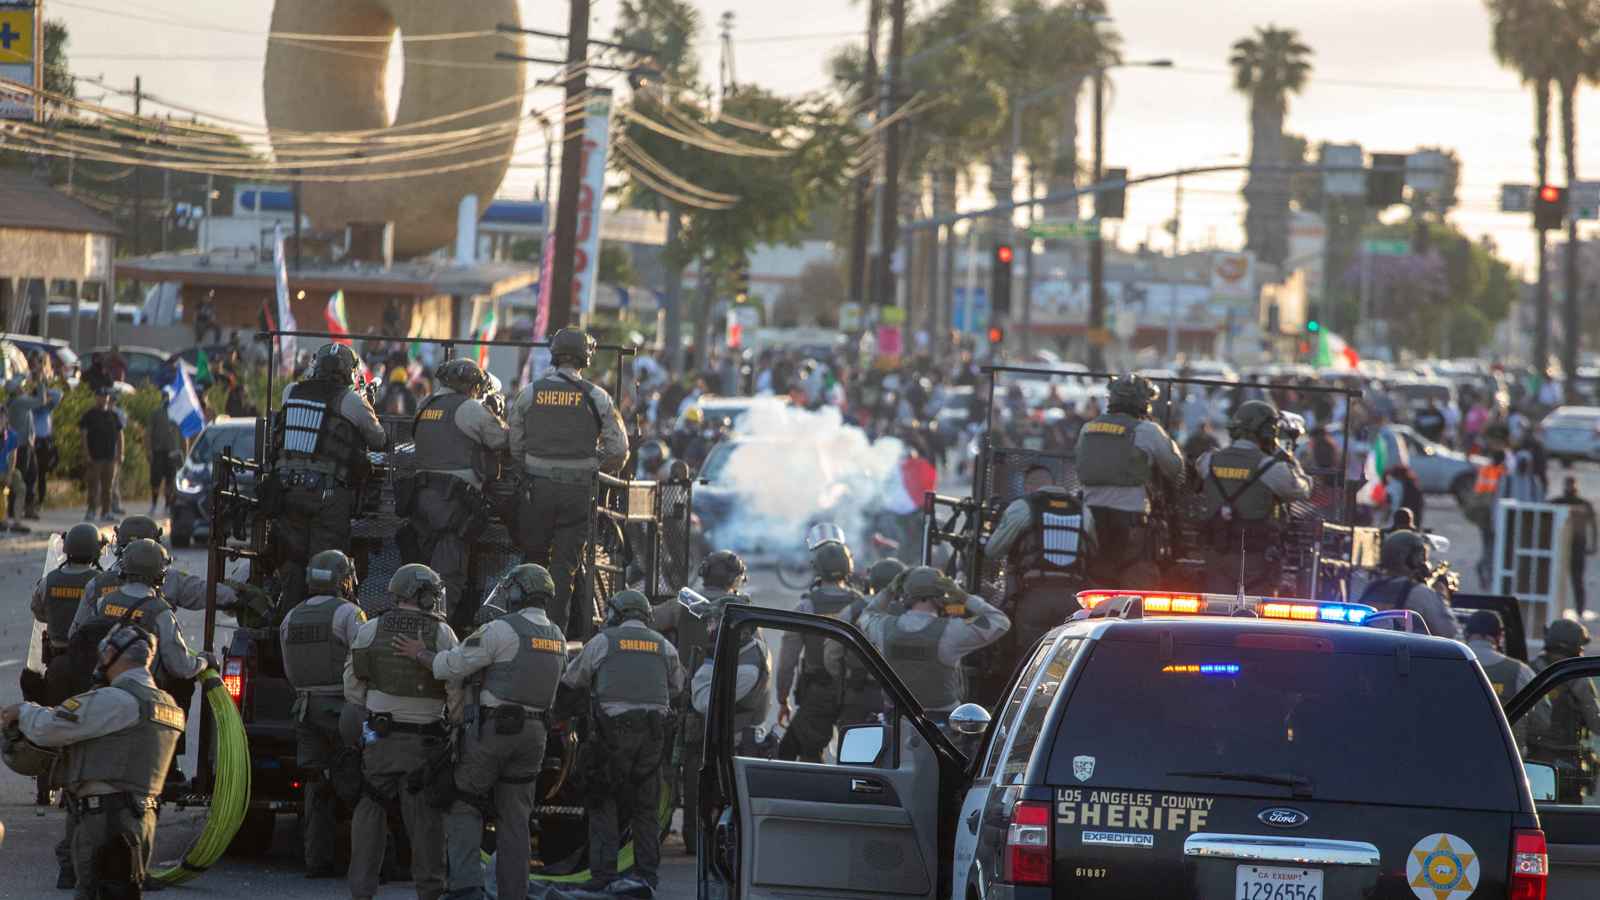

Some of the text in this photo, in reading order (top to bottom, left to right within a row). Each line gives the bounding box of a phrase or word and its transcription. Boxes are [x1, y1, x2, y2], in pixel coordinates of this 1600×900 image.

[536, 391, 583, 406] SHERIFF
[619, 638, 659, 652] SHERIFF
[1058, 789, 1214, 810] LOS ANGELES COUNTY
[1057, 802, 1209, 832] SHERIFF
[1269, 810, 1297, 823] Ford
[1083, 832, 1153, 844] EXPEDITION
[1241, 881, 1317, 900] 1296556
